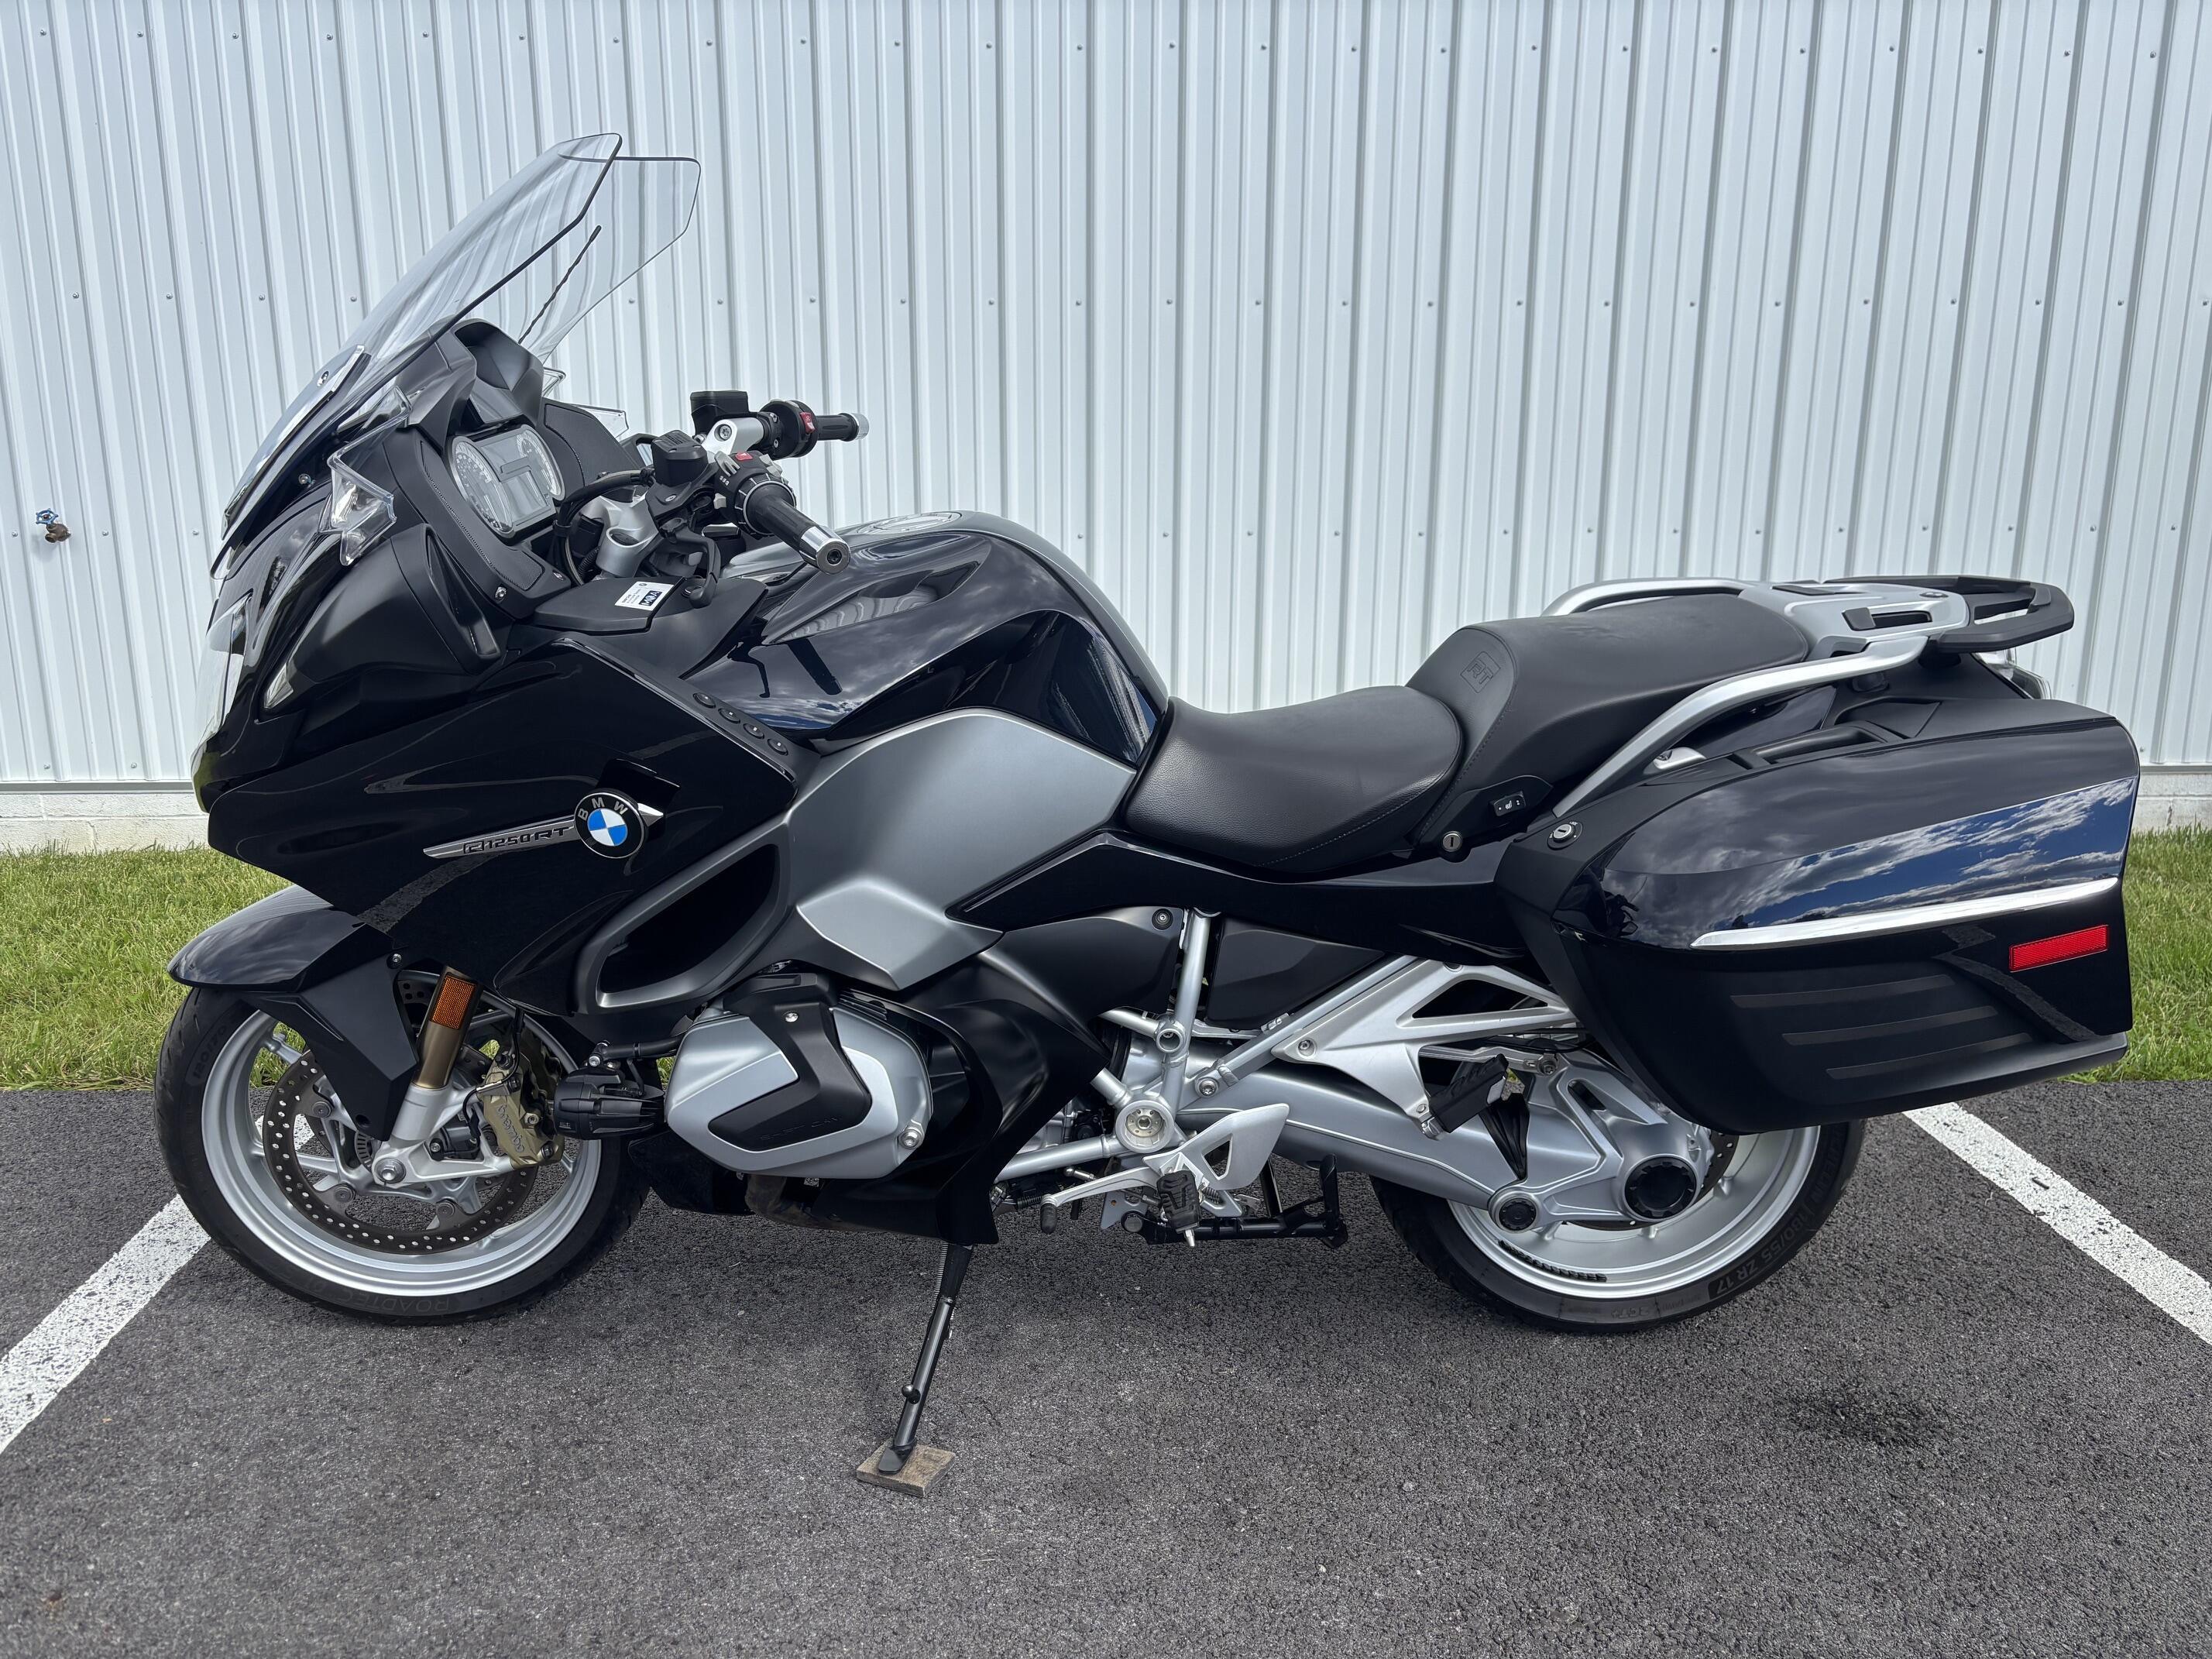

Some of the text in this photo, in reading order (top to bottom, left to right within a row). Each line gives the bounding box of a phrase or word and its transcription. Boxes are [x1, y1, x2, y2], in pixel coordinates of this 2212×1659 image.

[1467, 658, 1494, 685] RT
[578, 797, 629, 821] BMW
[1736, 1260, 1759, 1280] ZR
[1716, 1276, 1735, 1295] 17
[338, 1288, 450, 1312] ROADTEC
